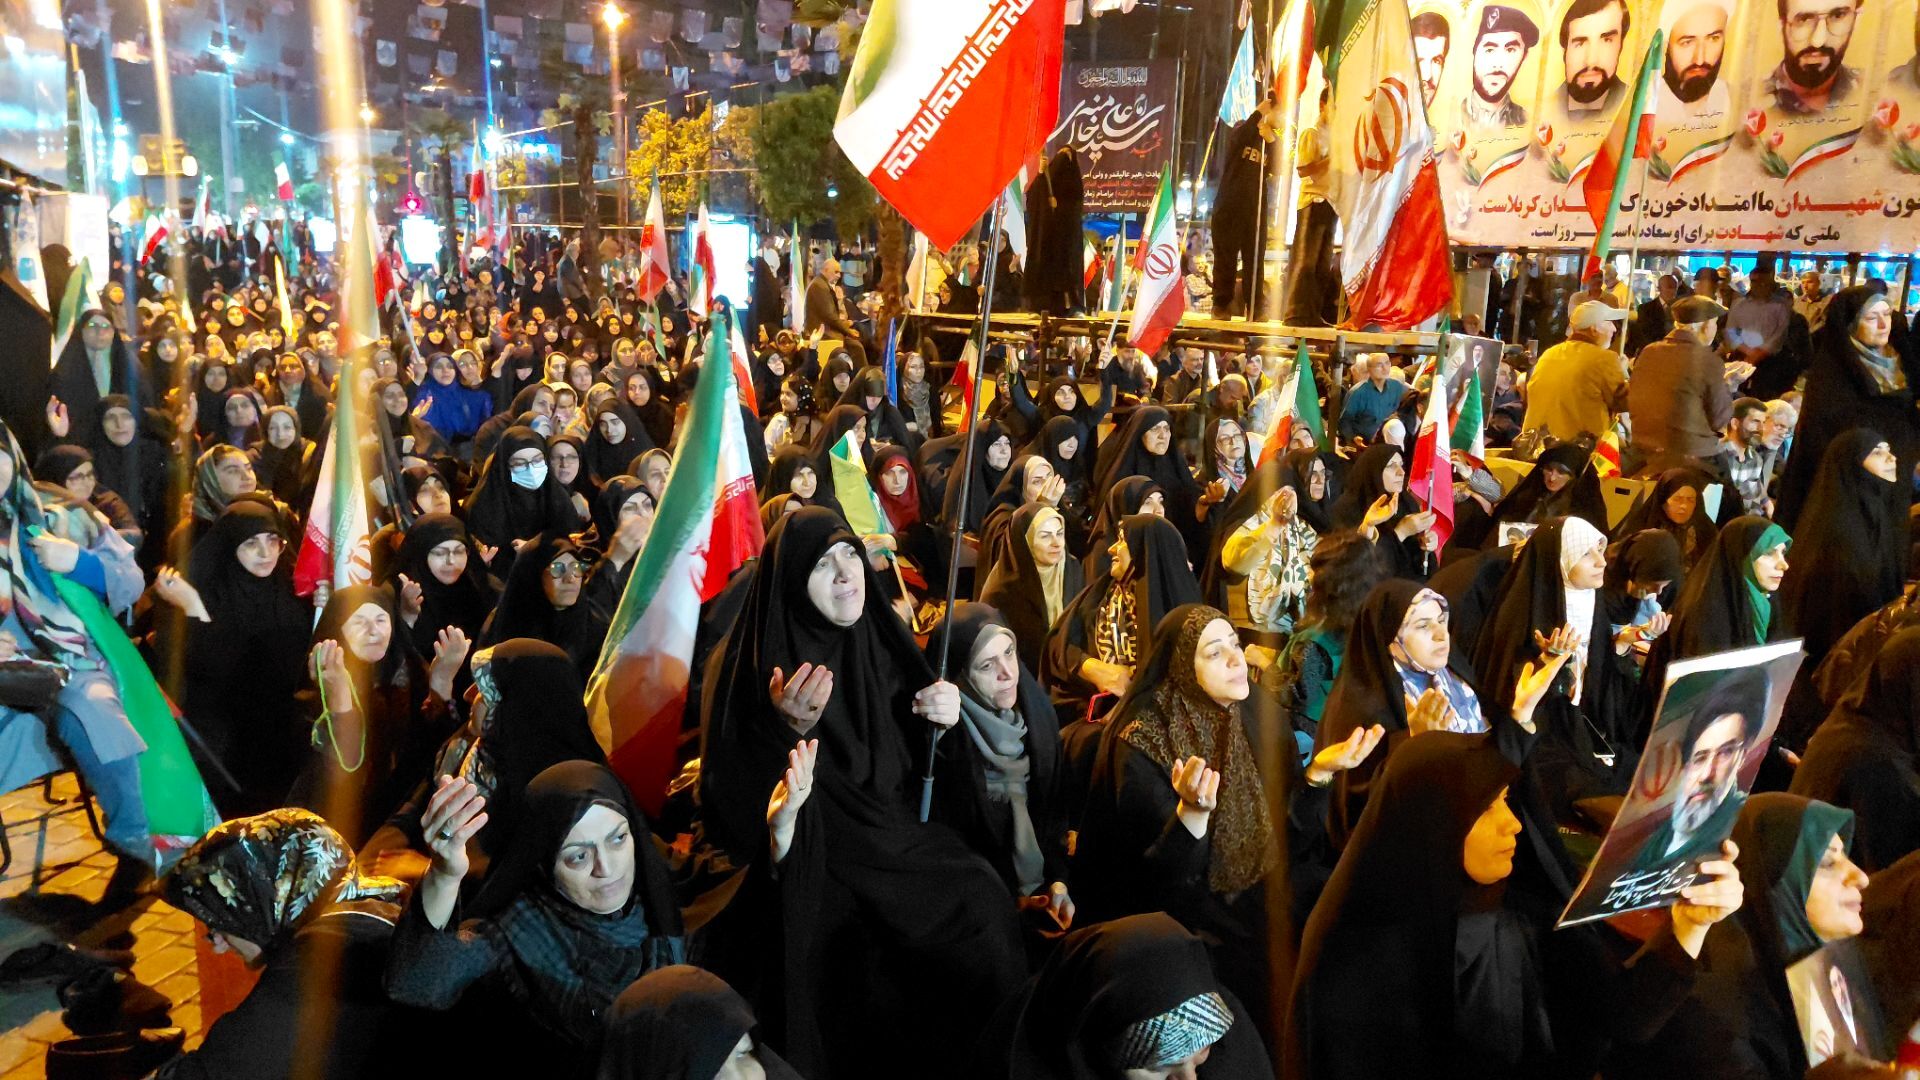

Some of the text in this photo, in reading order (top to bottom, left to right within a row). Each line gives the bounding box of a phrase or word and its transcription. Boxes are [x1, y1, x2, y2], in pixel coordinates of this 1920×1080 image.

[1145, 170, 1162, 179] هادت
[1619, 192, 1650, 218] پک
[1650, 192, 1688, 218] خون
[1689, 191, 1757, 212] امتداد
[1774, 188, 1884, 218] شهیدان
[1715, 224, 1784, 243] شهادت
[1785, 224, 1804, 241] که
[1803, 224, 1841, 246] ملتی
